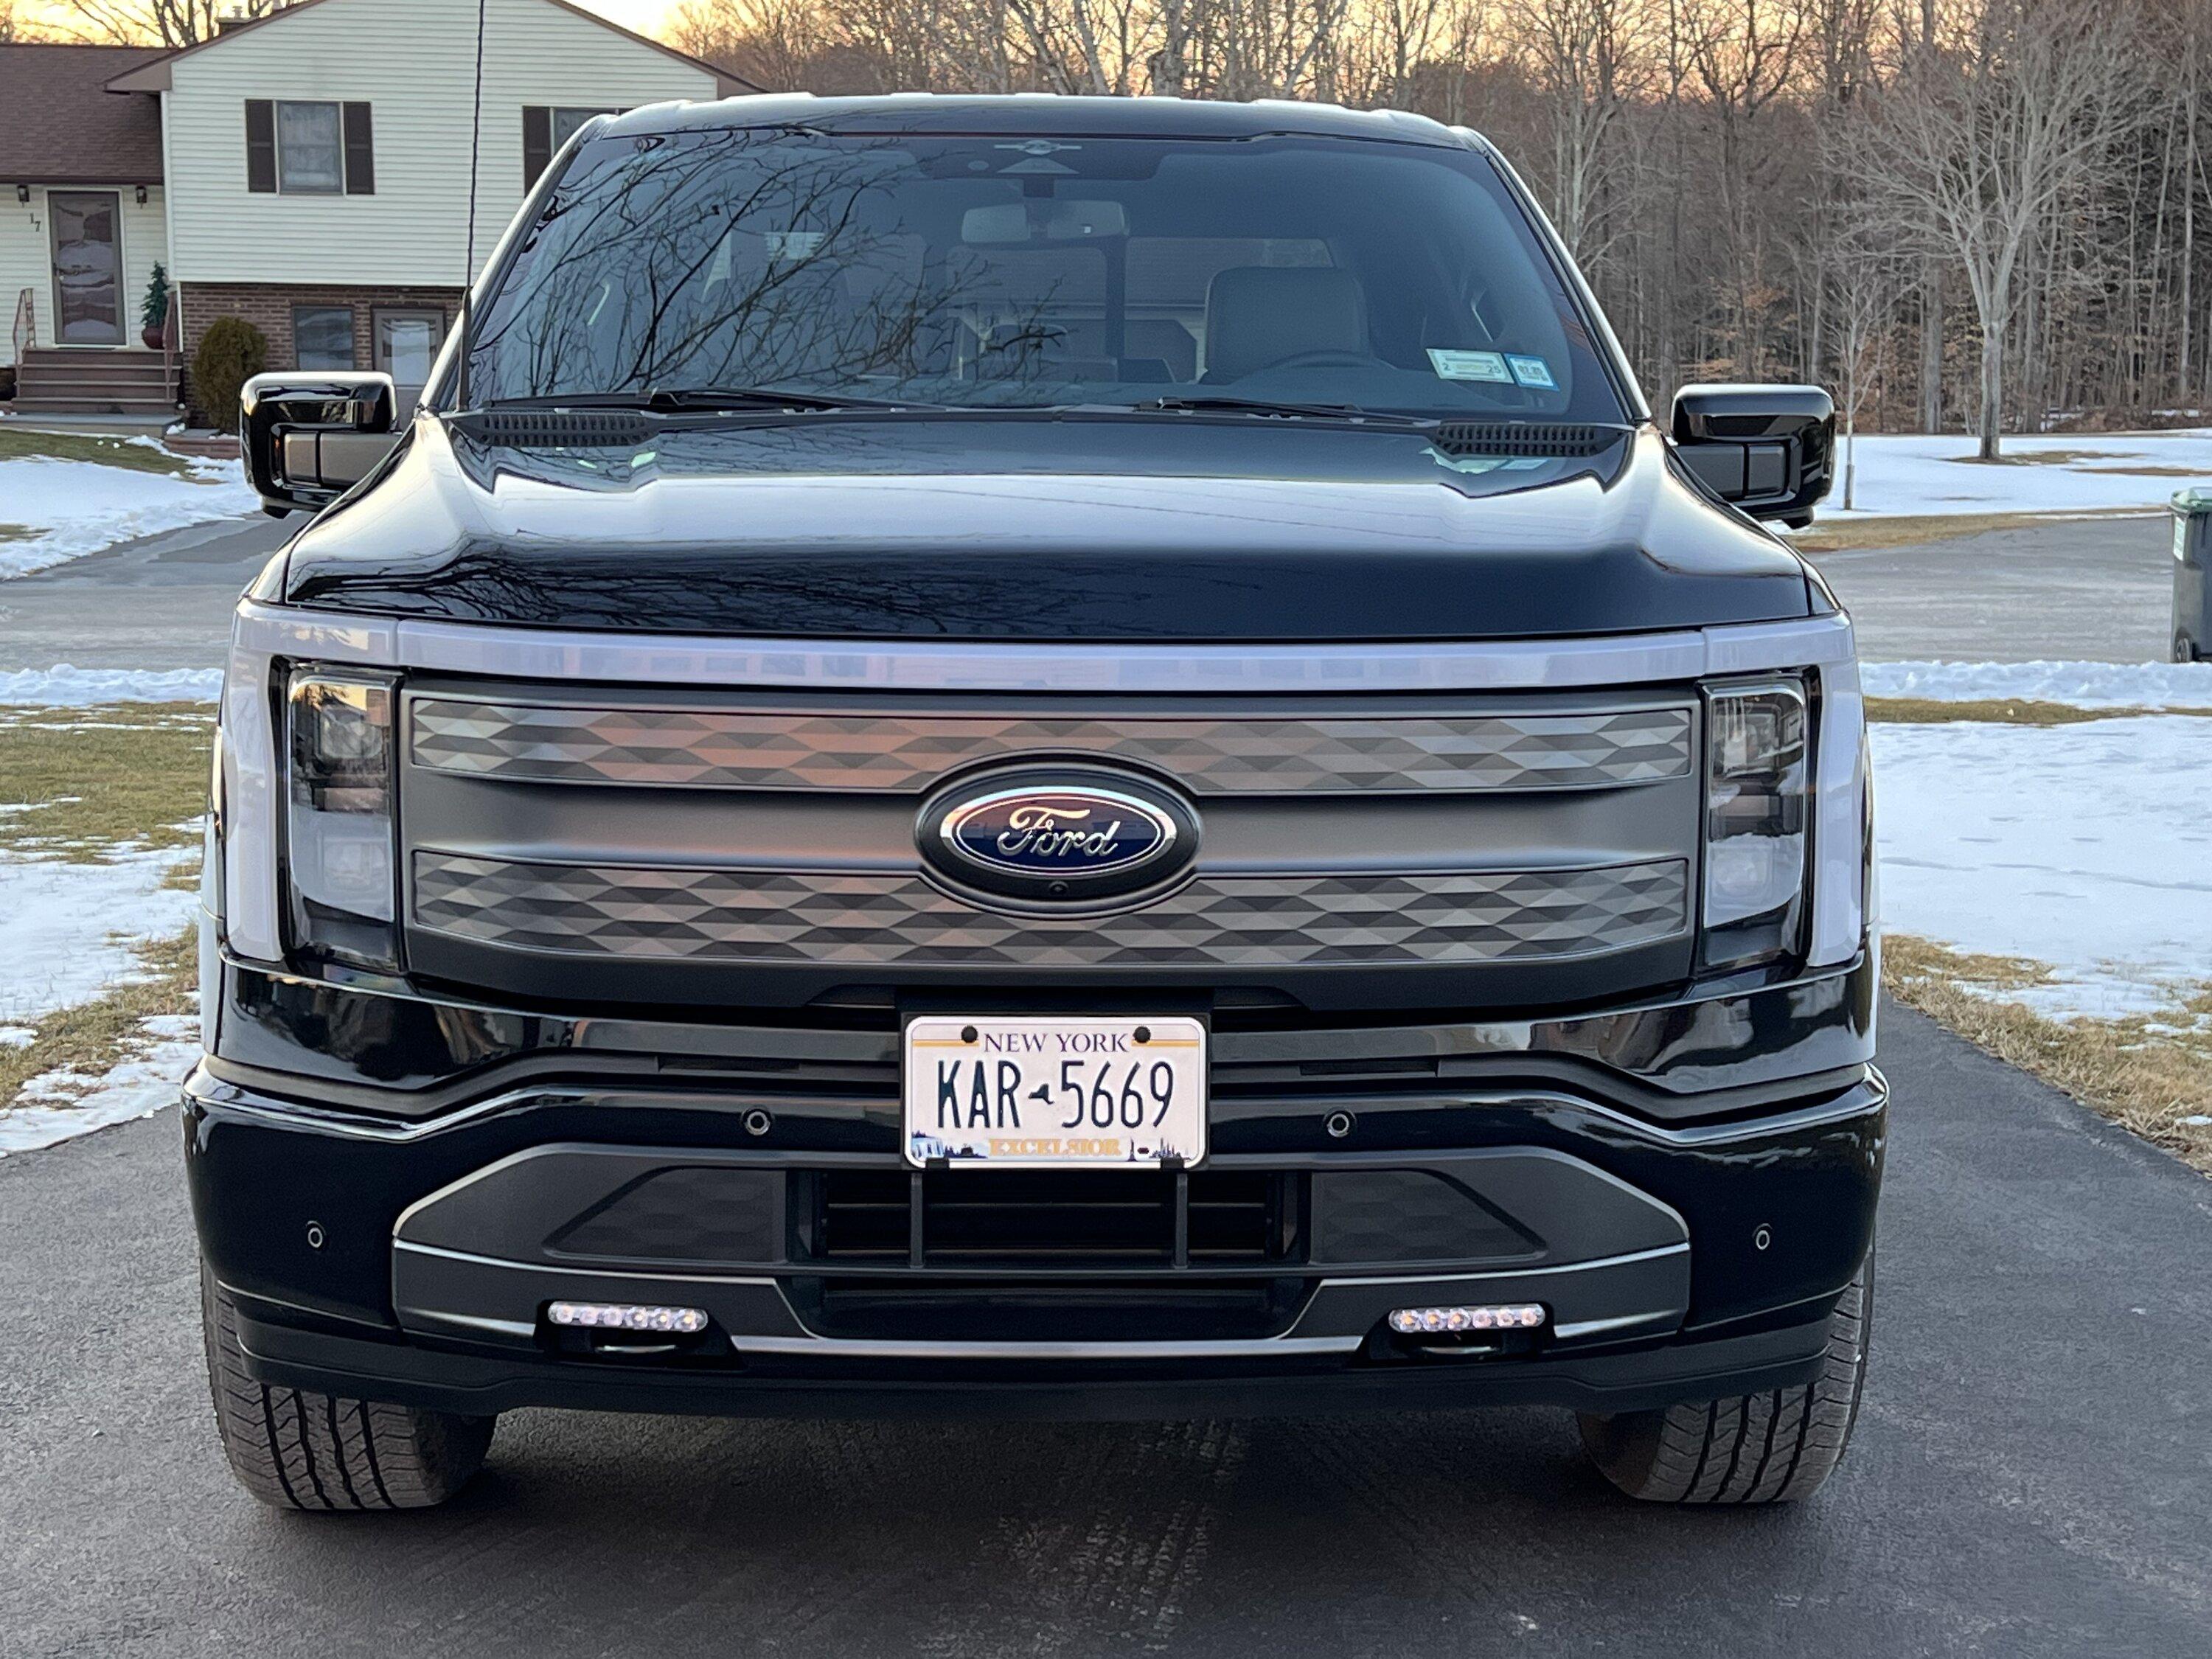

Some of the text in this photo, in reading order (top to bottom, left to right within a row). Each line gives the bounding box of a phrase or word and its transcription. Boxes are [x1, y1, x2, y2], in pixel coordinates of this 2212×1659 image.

[29, 212, 41, 232] 17
[997, 806, 1121, 857] Ford
[984, 1033, 1130, 1053] NEW YORK
[938, 1060, 1174, 1128] KAR 5669
[989, 1138, 1121, 1156] EXCELSIOR
